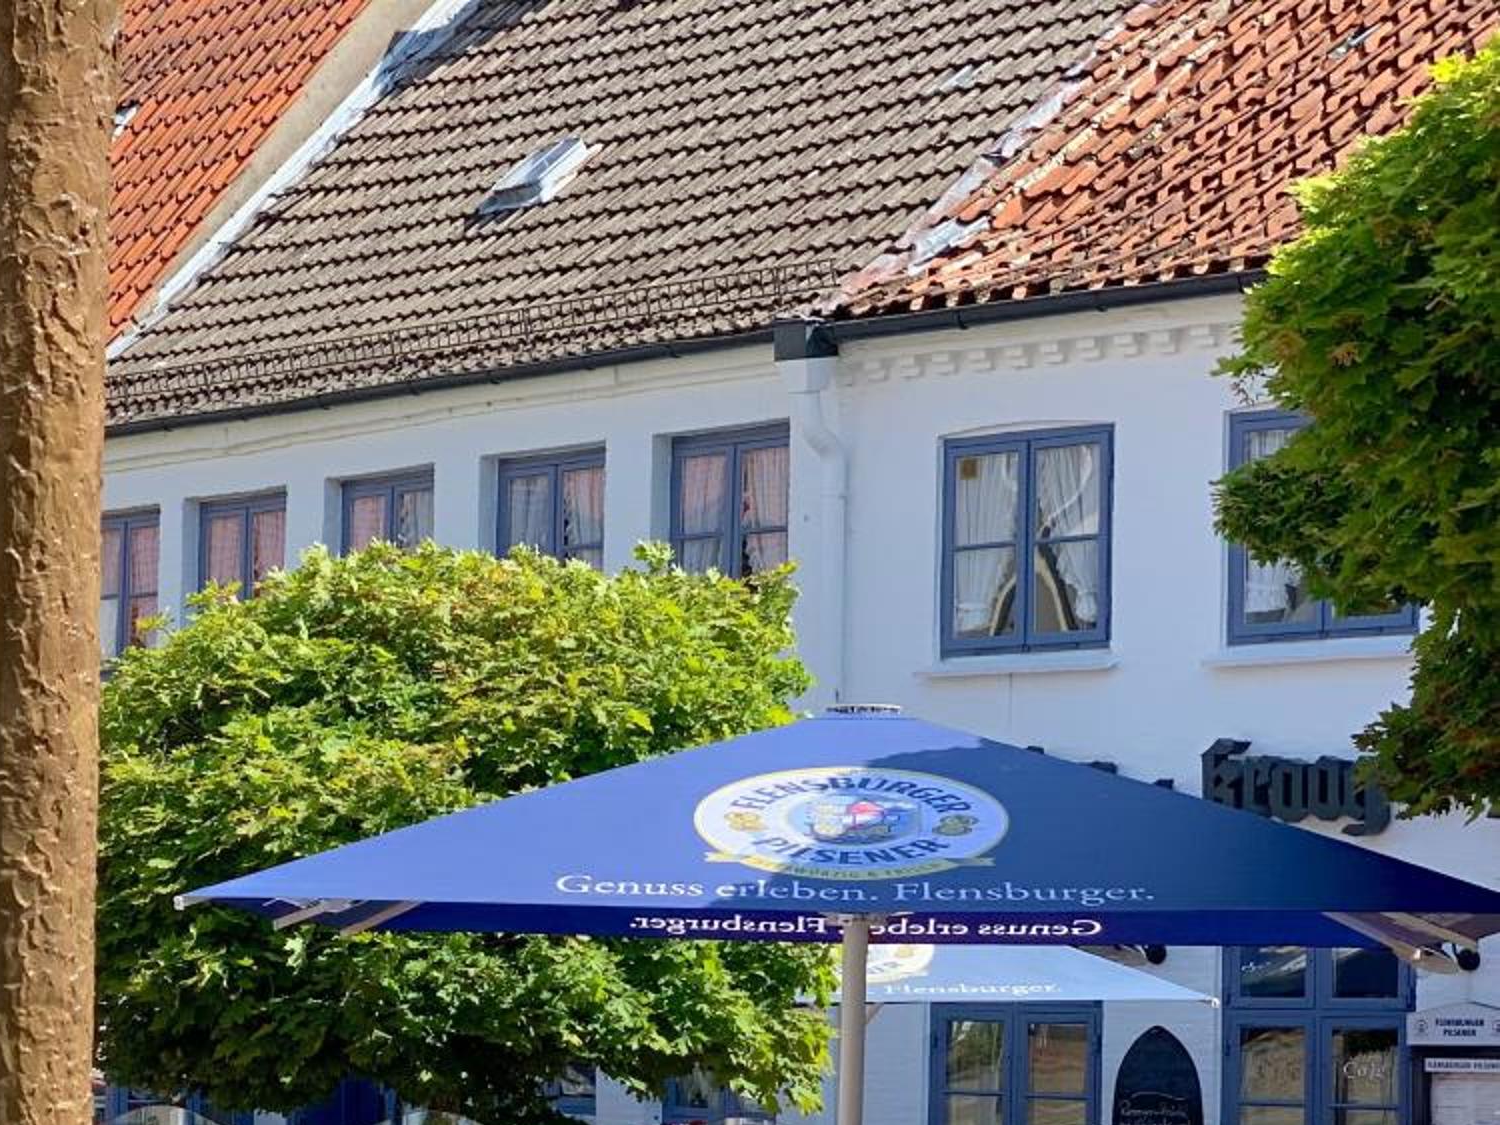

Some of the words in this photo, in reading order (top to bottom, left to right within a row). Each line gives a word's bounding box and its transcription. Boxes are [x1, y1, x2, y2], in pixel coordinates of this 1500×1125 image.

[730, 777, 972, 813] FLENSBURGER
[752, 836, 952, 865] PILSENER
[556, 875, 704, 896] Genuss
[715, 880, 877, 901] erleben.
[894, 881, 1154, 906] Flensburger.
[884, 983, 1062, 996] Flensburger.
